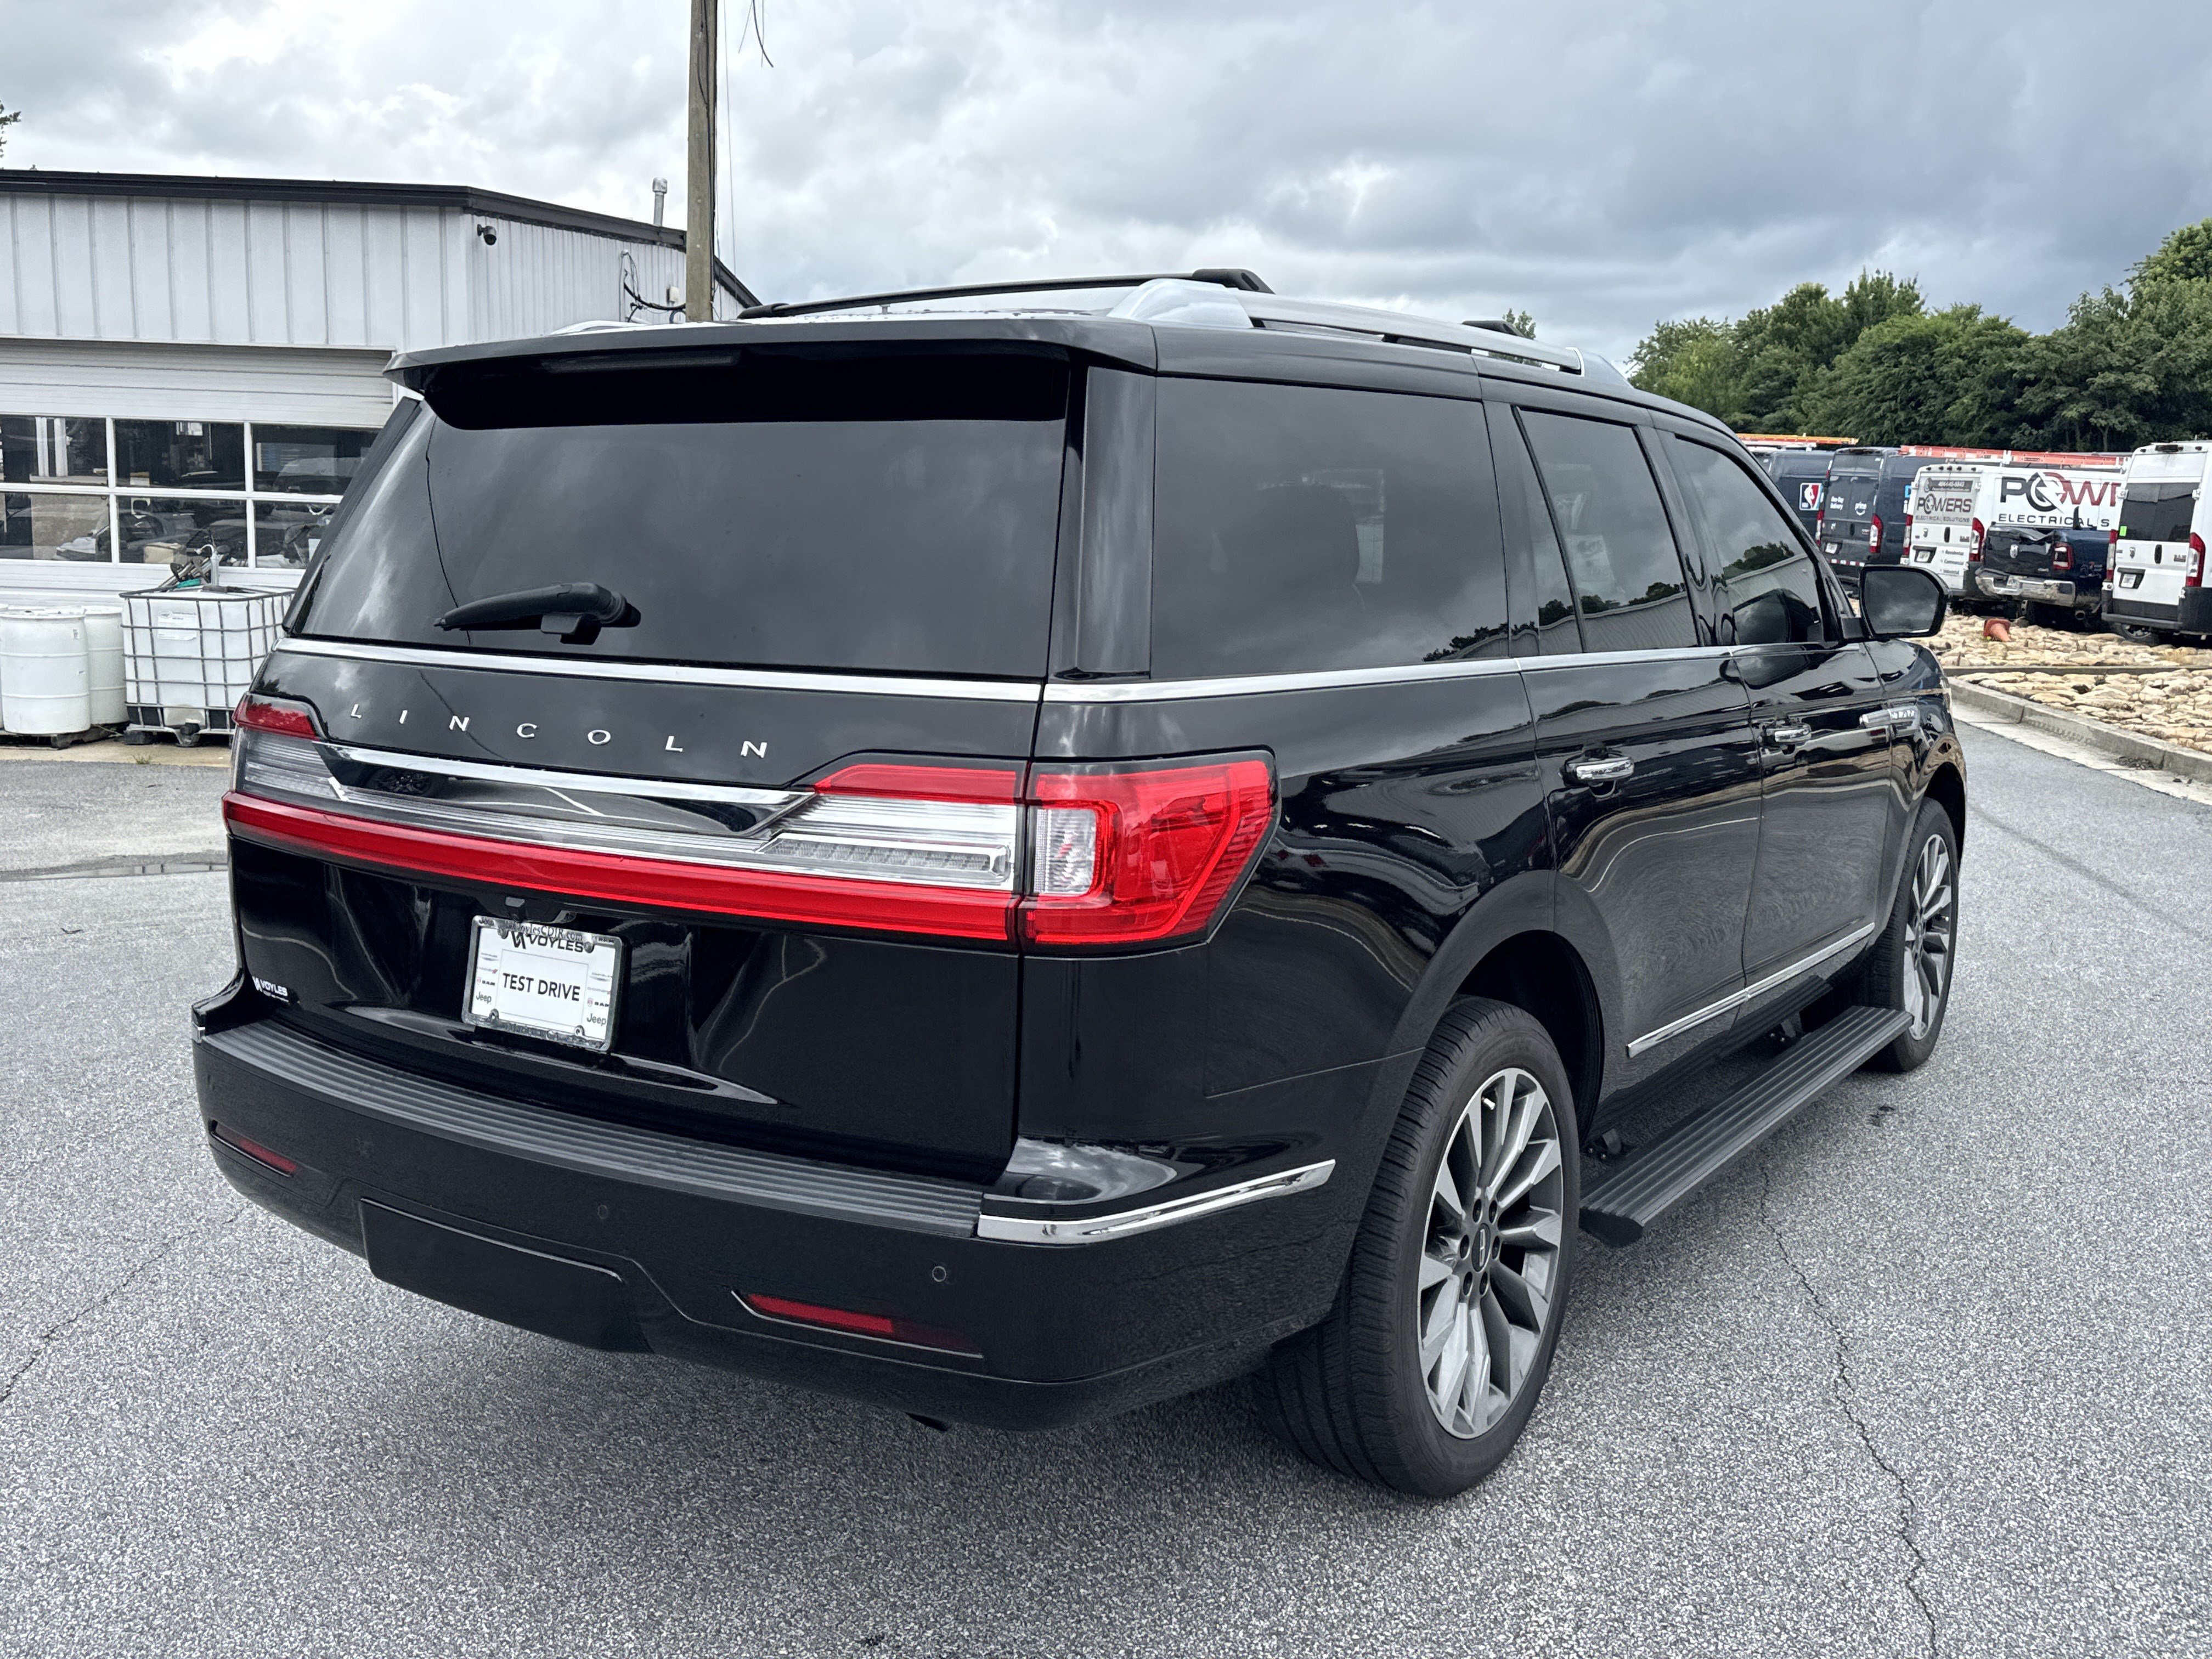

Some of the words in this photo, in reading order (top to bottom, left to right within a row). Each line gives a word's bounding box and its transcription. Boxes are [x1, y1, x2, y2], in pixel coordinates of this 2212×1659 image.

[1917, 493, 1972, 514] POWERS
[351, 703, 768, 759] LINCOLN
[526, 933, 583, 953] VOYLES
[260, 979, 288, 997] VOYLES
[503, 973, 534, 993] TEST
[538, 980, 580, 1002] DRIVE
[476, 991, 492, 1005] Jeep
[586, 1012, 606, 1026] Jeep
